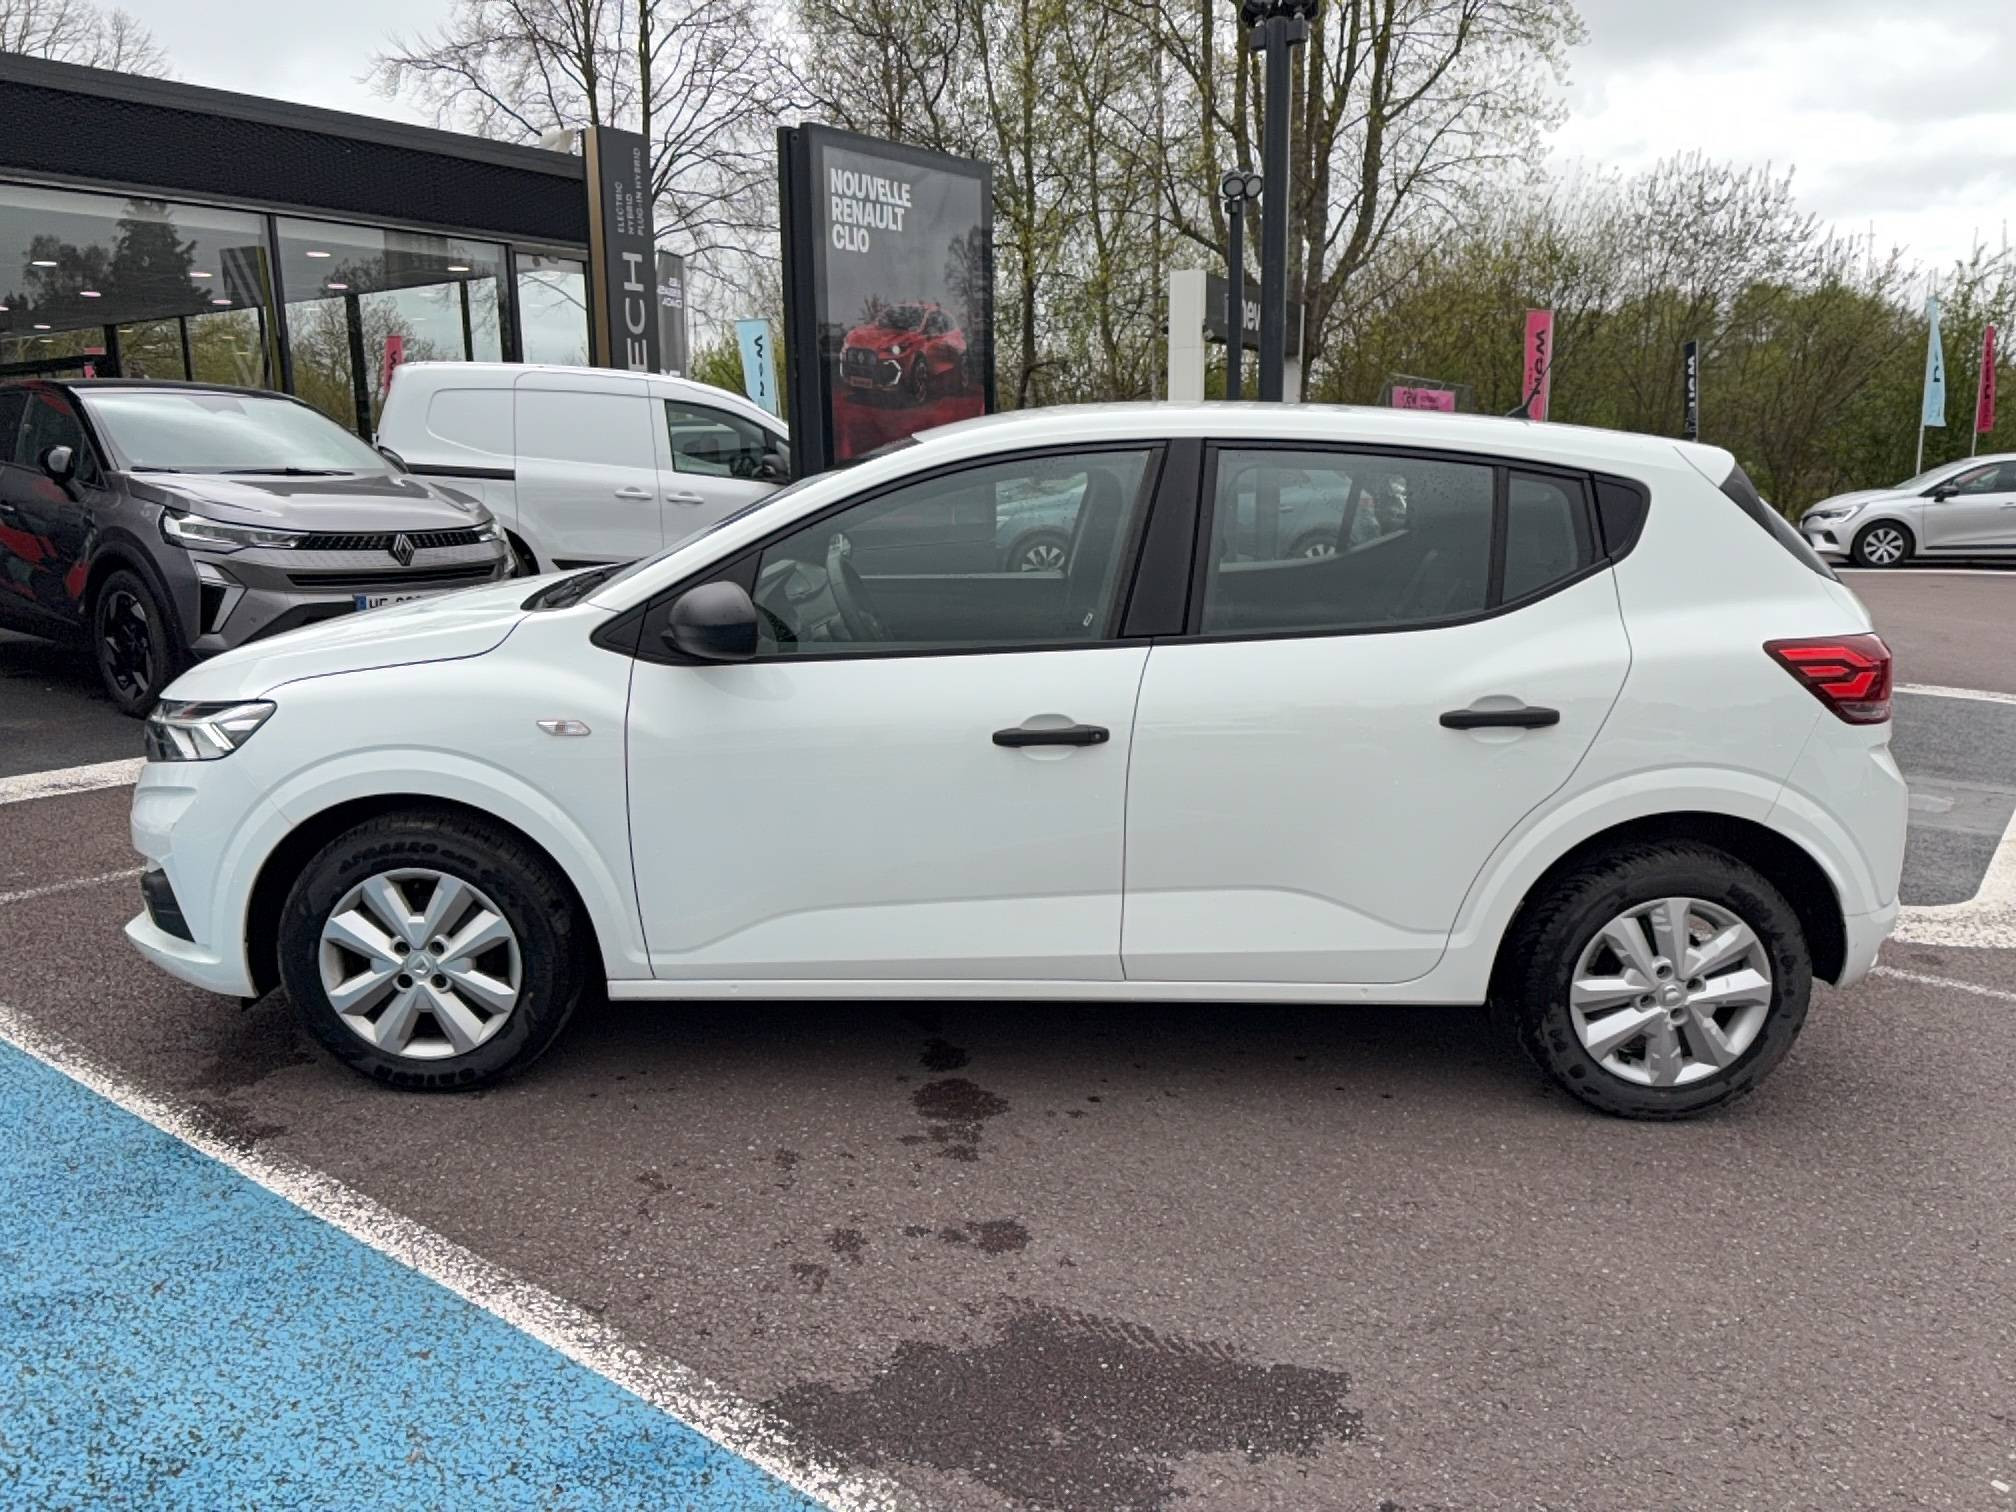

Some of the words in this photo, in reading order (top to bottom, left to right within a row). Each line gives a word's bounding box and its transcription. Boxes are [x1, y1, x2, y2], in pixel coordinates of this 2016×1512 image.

[633, 147, 642, 189] HYBRID
[831, 168, 912, 208] NOUVELLE
[614, 181, 625, 233] ELECTRIC
[625, 193, 635, 235] HYBRID
[832, 196, 905, 231] RENAULT
[832, 224, 870, 253] CLIO
